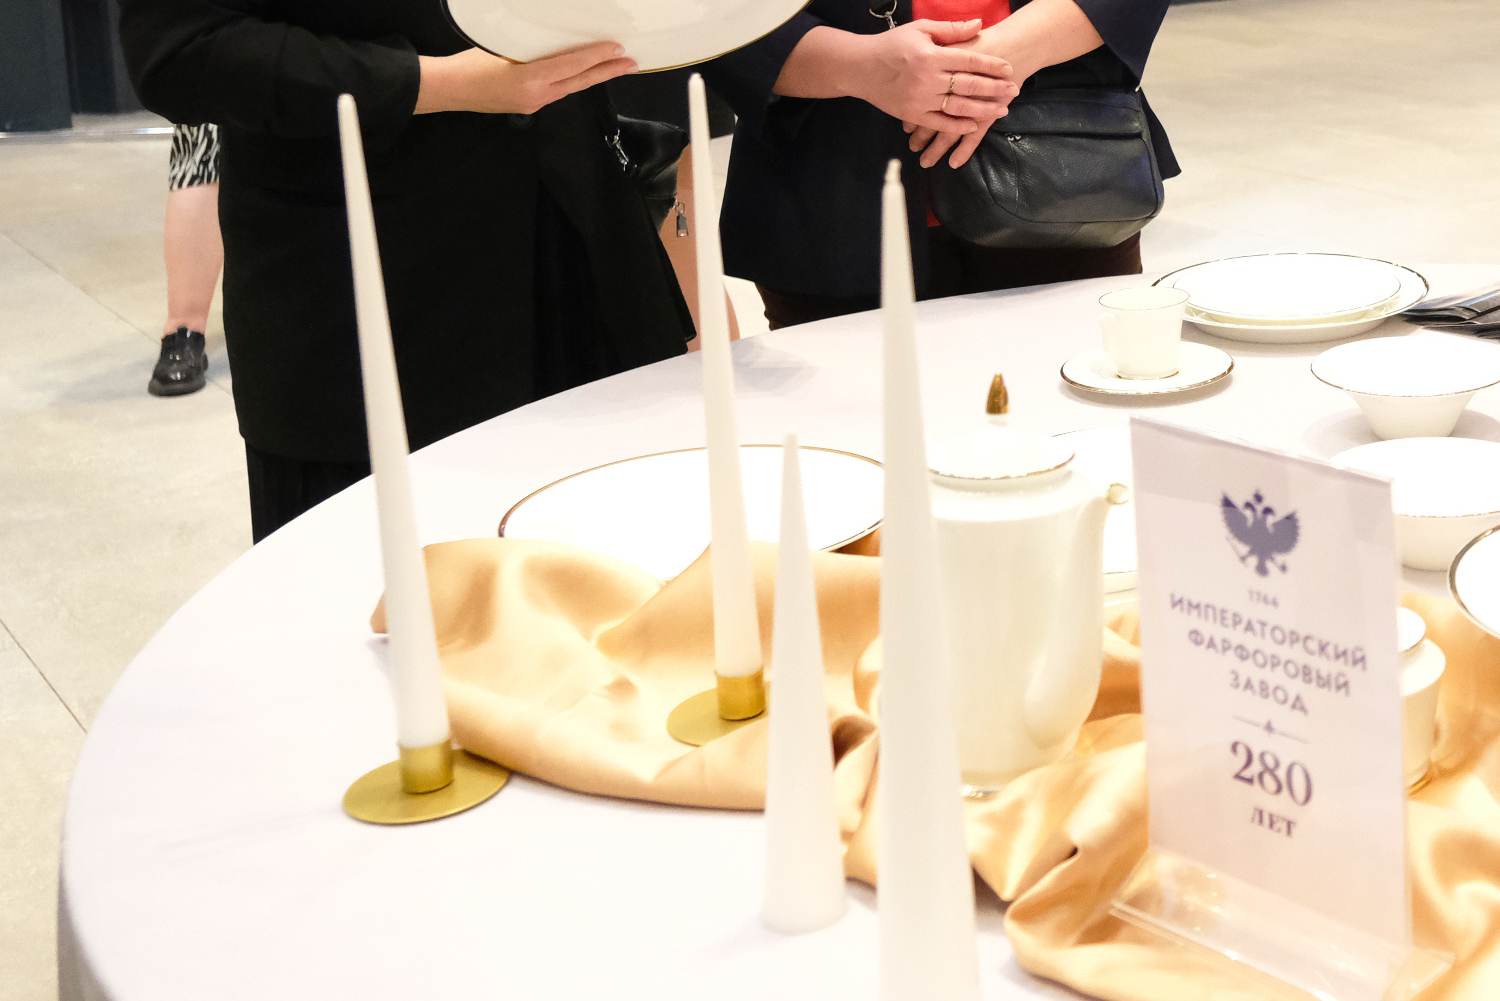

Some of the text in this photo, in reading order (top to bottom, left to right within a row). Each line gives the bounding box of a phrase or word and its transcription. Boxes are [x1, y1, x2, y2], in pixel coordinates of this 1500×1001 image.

[1169, 592, 1367, 673] ИМПЕРАТОРСКИЙ
[1187, 628, 1351, 697] ФАРФОРОВЫЙ
[1229, 668, 1309, 717] ЗАВОД
[1229, 740, 1314, 807] 280
[1250, 806, 1297, 838] ЛЕТ
